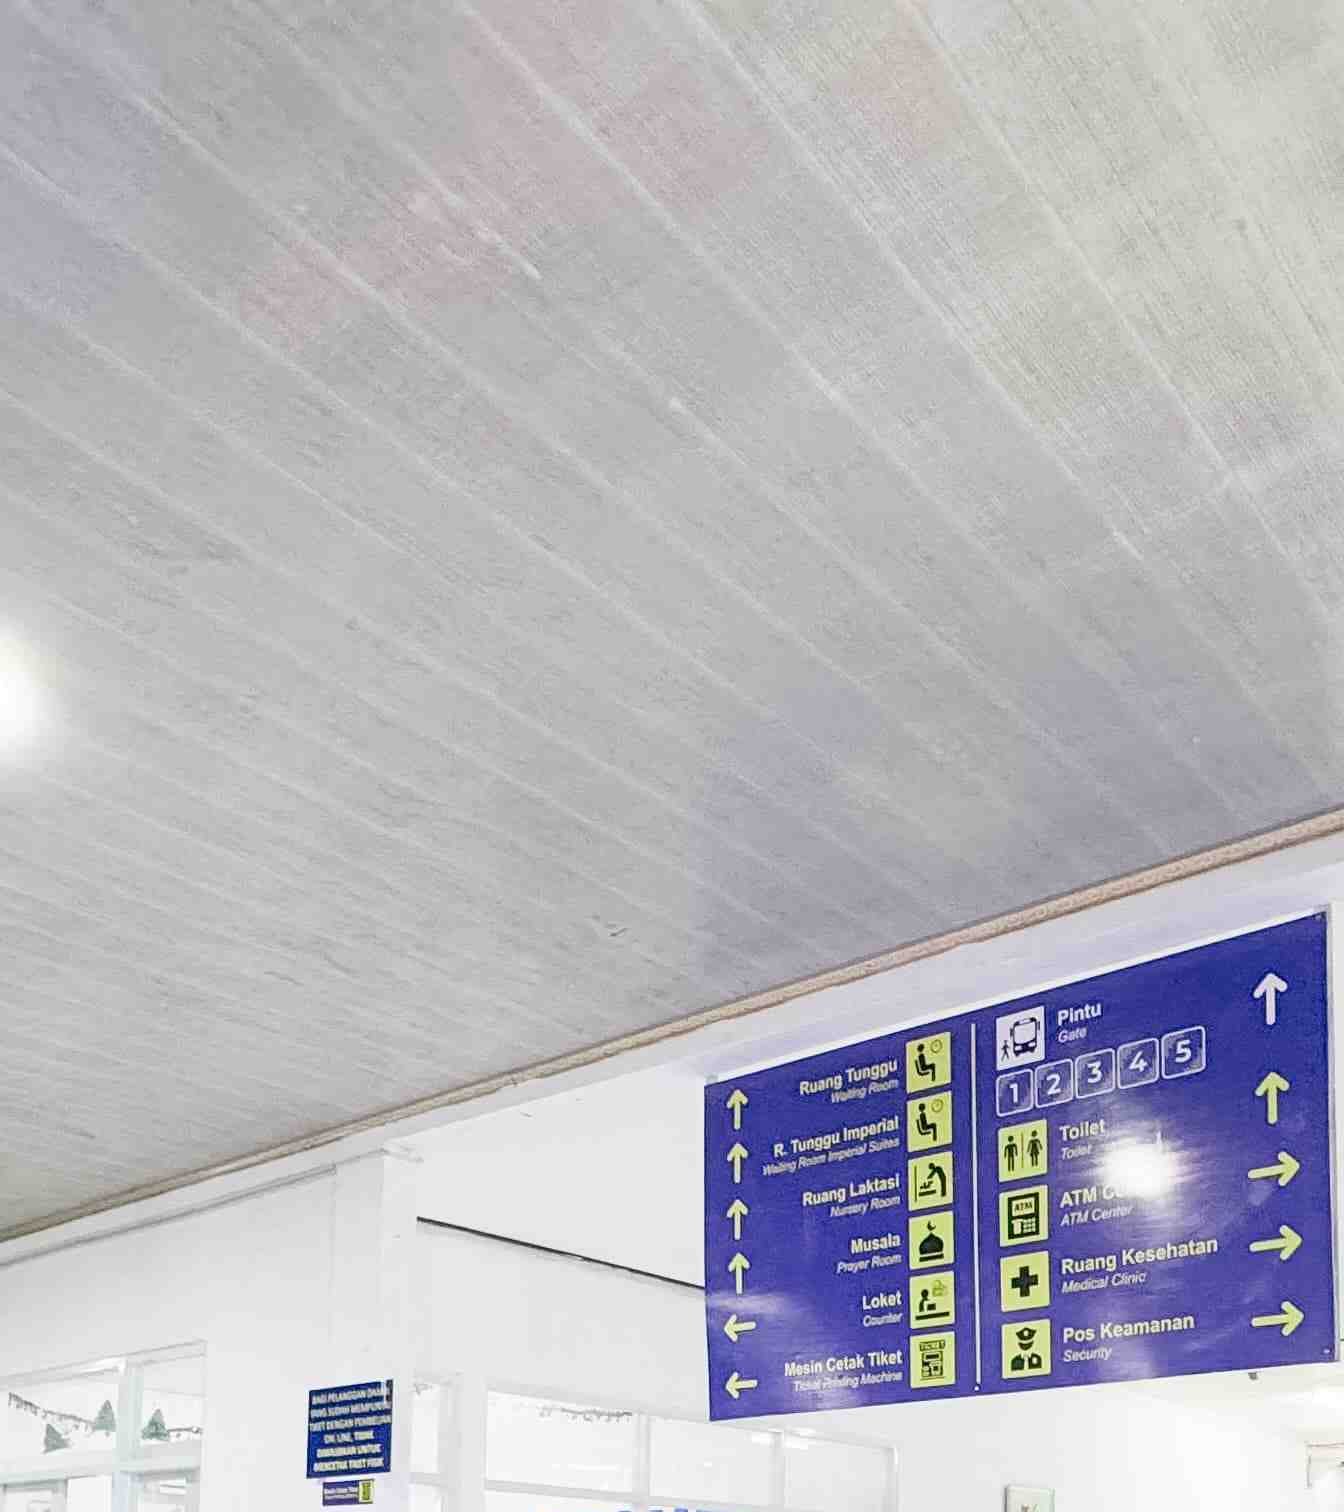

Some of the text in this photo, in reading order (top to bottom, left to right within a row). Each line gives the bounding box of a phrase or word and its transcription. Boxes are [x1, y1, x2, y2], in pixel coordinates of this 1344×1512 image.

[1056, 1003, 1102, 1026] Pintu
[1057, 1026, 1087, 1043] Gate
[799, 1059, 898, 1096] Ruang Tunggu
[1009, 1040, 1192, 1104] 1 2 3 4 5
[831, 1079, 899, 1103] Waiting Room
[773, 1115, 899, 1158] R. Tunggu Imperial
[1059, 1119, 1106, 1142] Toilet
[802, 1173, 900, 1207] Ruang Laktasi
[1060, 1187, 1097, 1208] ATM
[1060, 1205, 1133, 1227] ATM Center
[851, 1233, 901, 1255] Musala
[836, 1259, 870, 1275] Prayer
[1061, 1237, 1218, 1275] Ruang Kesehatan
[1061, 1270, 1147, 1294] Medical Clinic
[862, 1290, 902, 1311] Loket
[863, 1312, 903, 1328] Counter
[1063, 1315, 1195, 1344] Pos Keamanan
[784, 1350, 903, 1377] Mesin Cetak Tiket
[1063, 1345, 1112, 1363] Security
